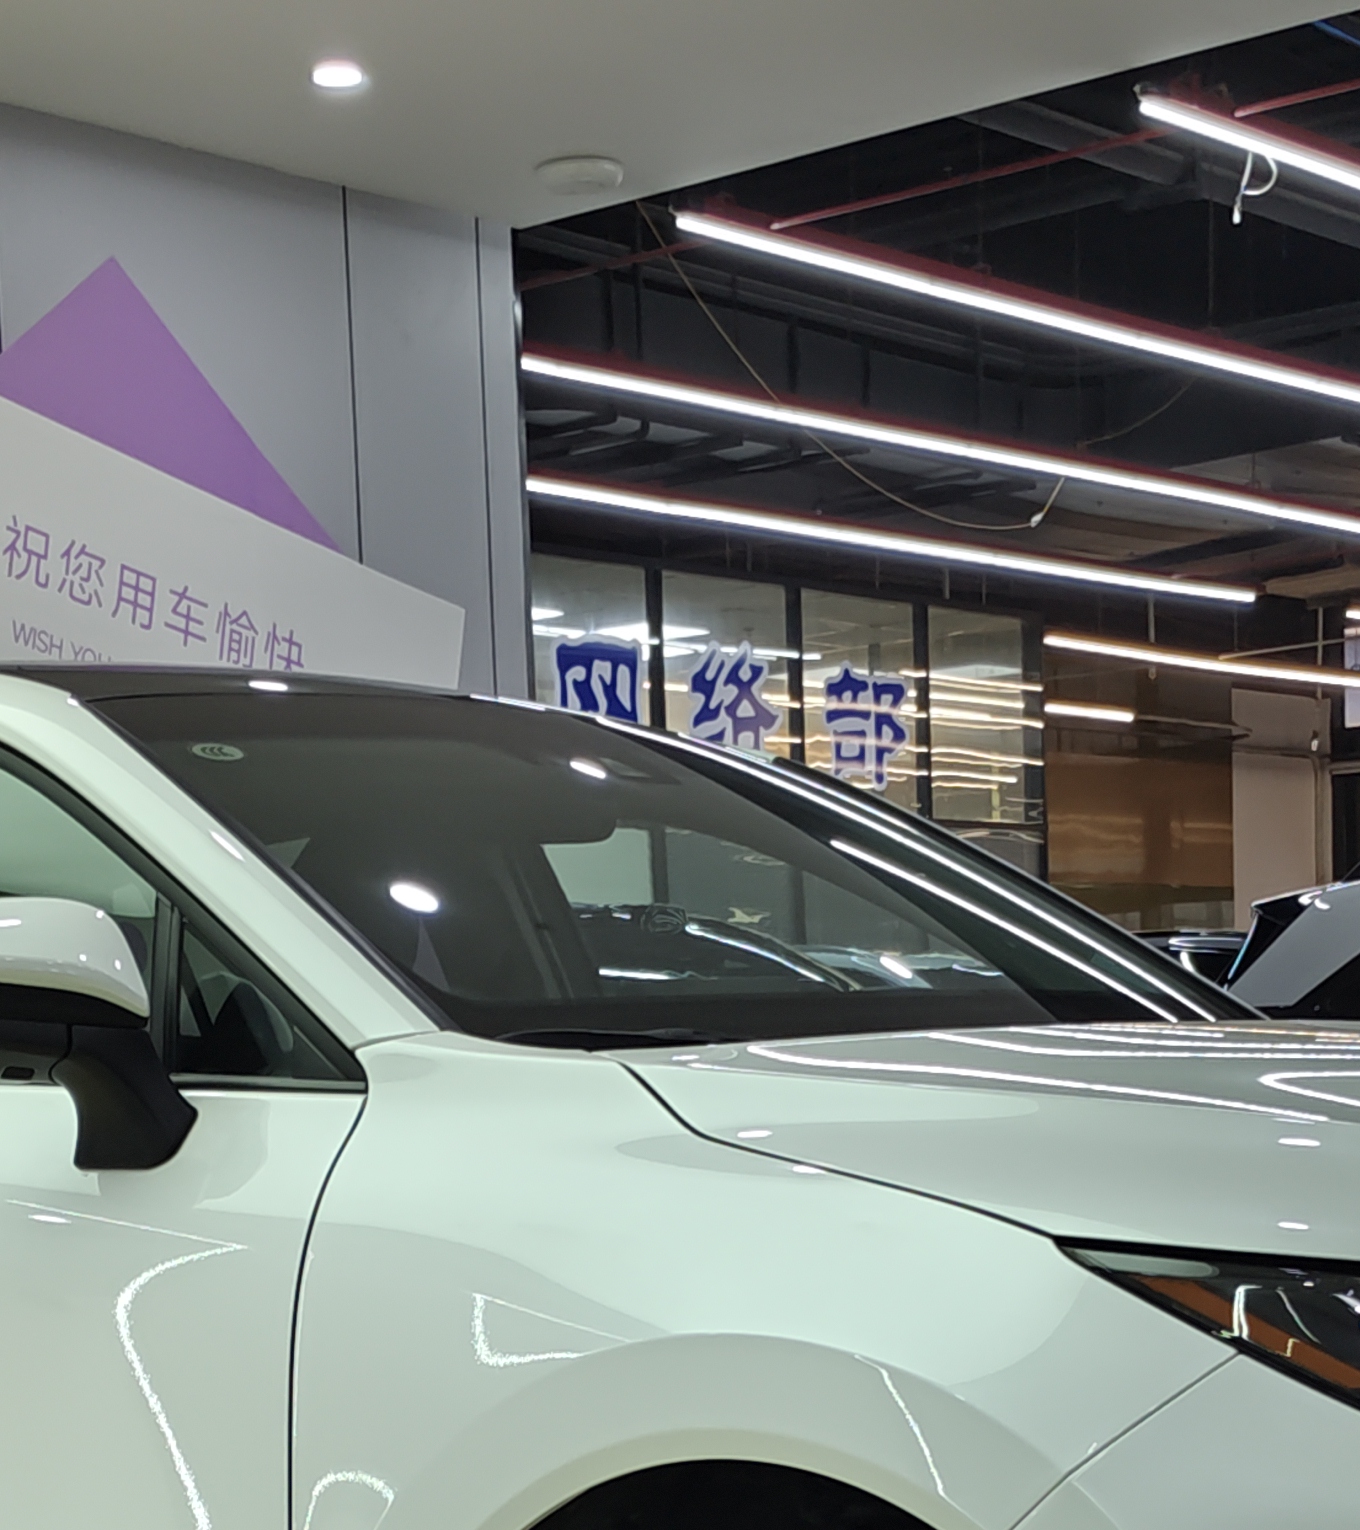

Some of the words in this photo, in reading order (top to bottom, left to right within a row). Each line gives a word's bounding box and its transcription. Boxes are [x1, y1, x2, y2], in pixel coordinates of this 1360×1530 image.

[2, 515, 305, 671] 祝您用车愉快
[12, 619, 64, 661] WISH
[554, 640, 908, 787] 网络部
